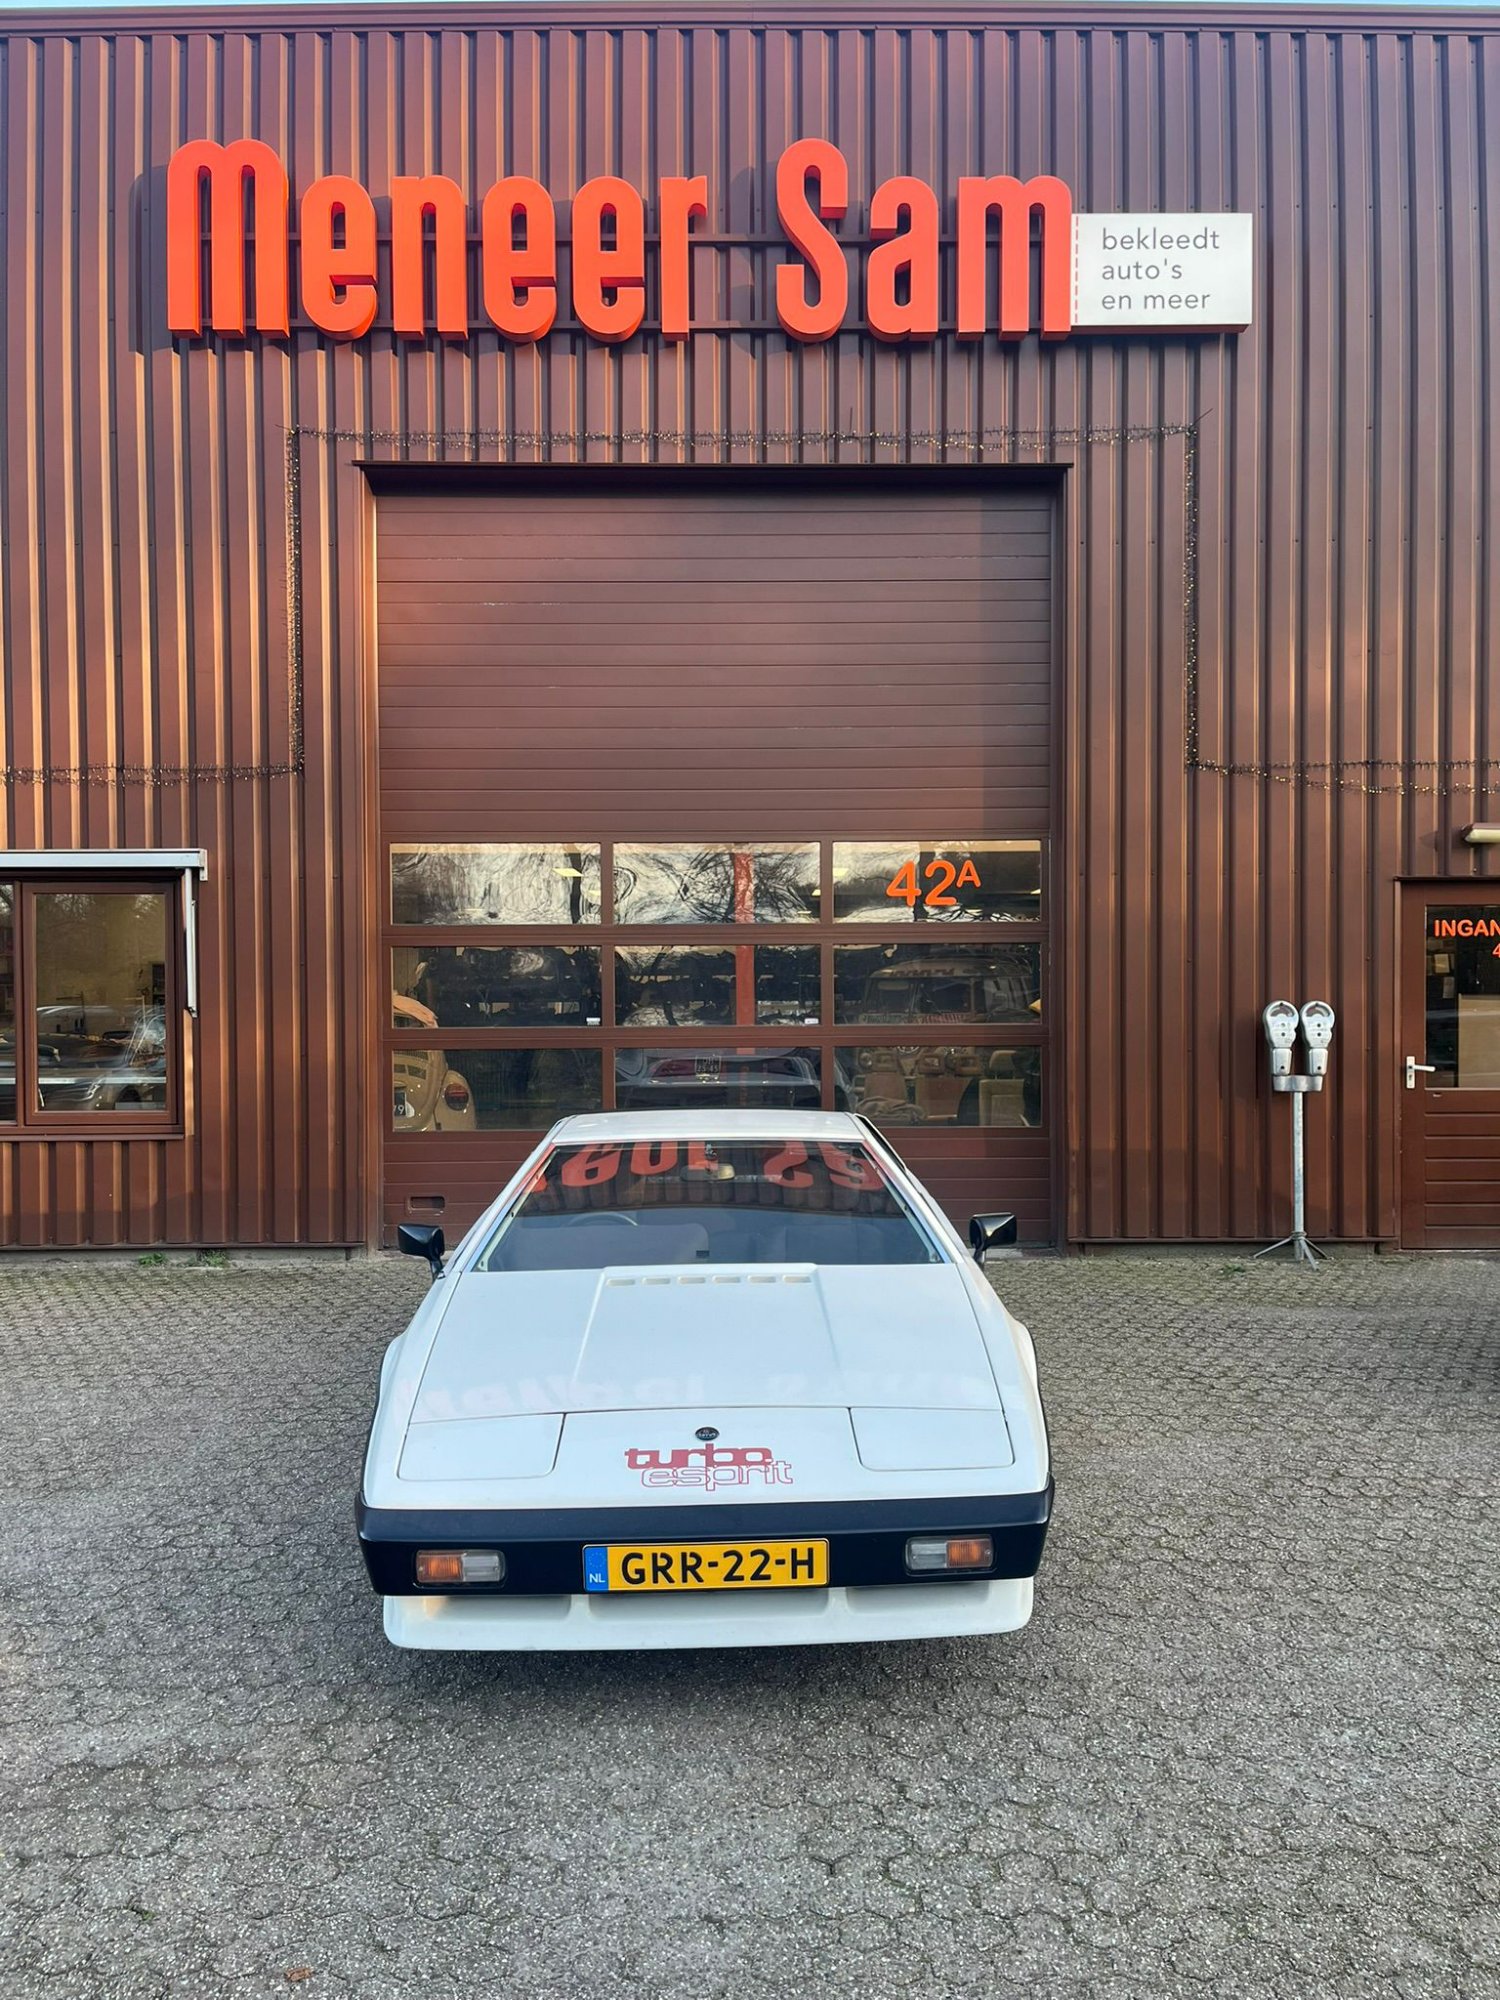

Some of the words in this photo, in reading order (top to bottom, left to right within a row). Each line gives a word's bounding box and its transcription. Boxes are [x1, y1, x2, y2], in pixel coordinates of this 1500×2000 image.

[167, 138, 708, 341] Meneer
[776, 138, 1073, 341] Sam
[1102, 227, 1220, 250] bekleedt
[1102, 258, 1182, 280] auto's
[1102, 294, 1132, 309] en
[1144, 293, 1211, 309] meer
[886, 859, 981, 907] 42A
[624, 1443, 774, 1469] turbo
[641, 1460, 794, 1491] esprit
[589, 1573, 605, 1584] NL
[621, 1547, 815, 1585] GRR-22-H
